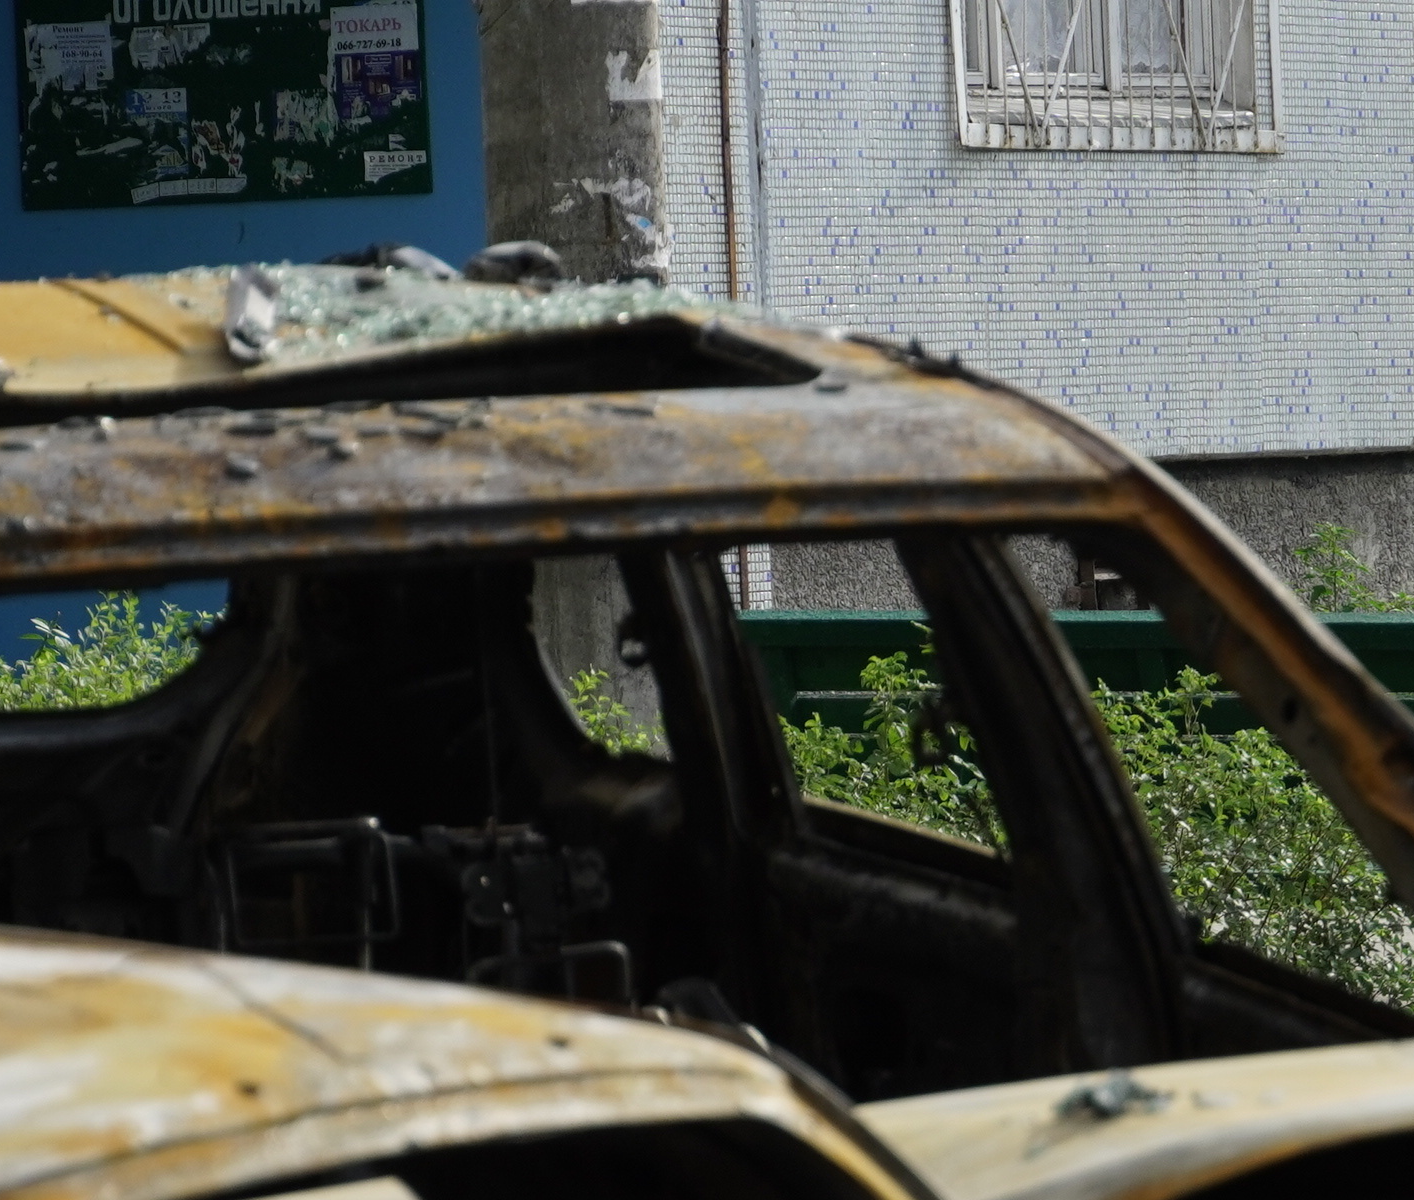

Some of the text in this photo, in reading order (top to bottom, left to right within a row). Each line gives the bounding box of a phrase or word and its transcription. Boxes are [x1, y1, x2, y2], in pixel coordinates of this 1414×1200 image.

[52, 25, 84, 33] Ремонт
[334, 17, 402, 33] ТОКАРЬ
[369, 154, 423, 163] РЕМОНТ
